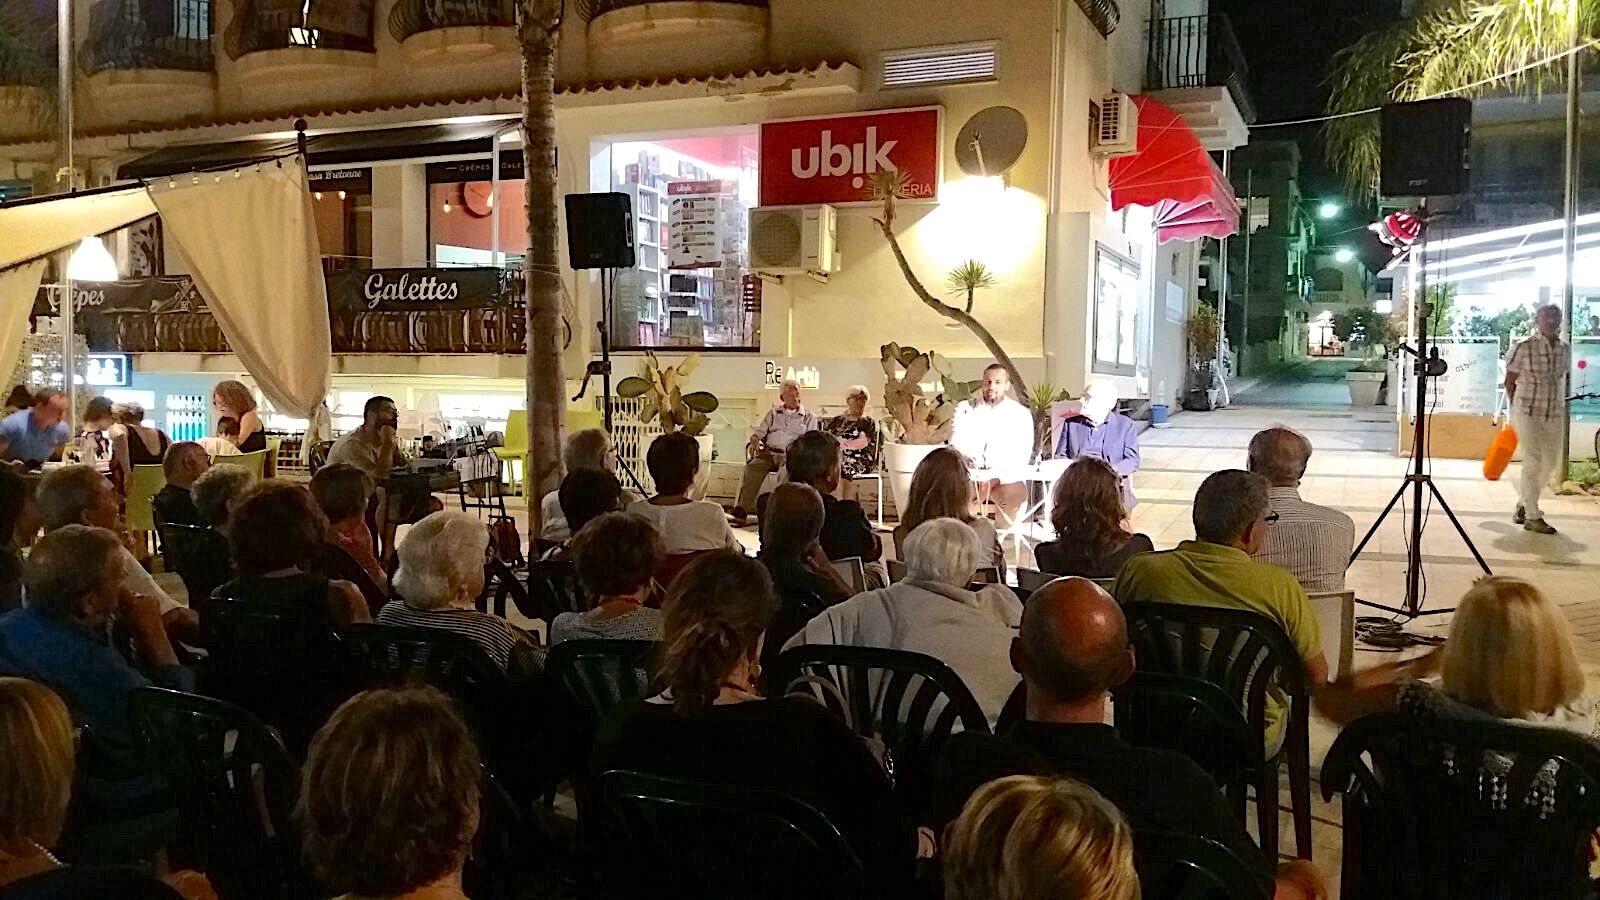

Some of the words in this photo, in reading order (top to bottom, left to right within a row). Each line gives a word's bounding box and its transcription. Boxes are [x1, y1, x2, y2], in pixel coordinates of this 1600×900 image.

[501, 161, 523, 169] GALE
[791, 126, 898, 189] ubik
[364, 273, 458, 309] Galettes
[765, 361, 782, 385] Re
